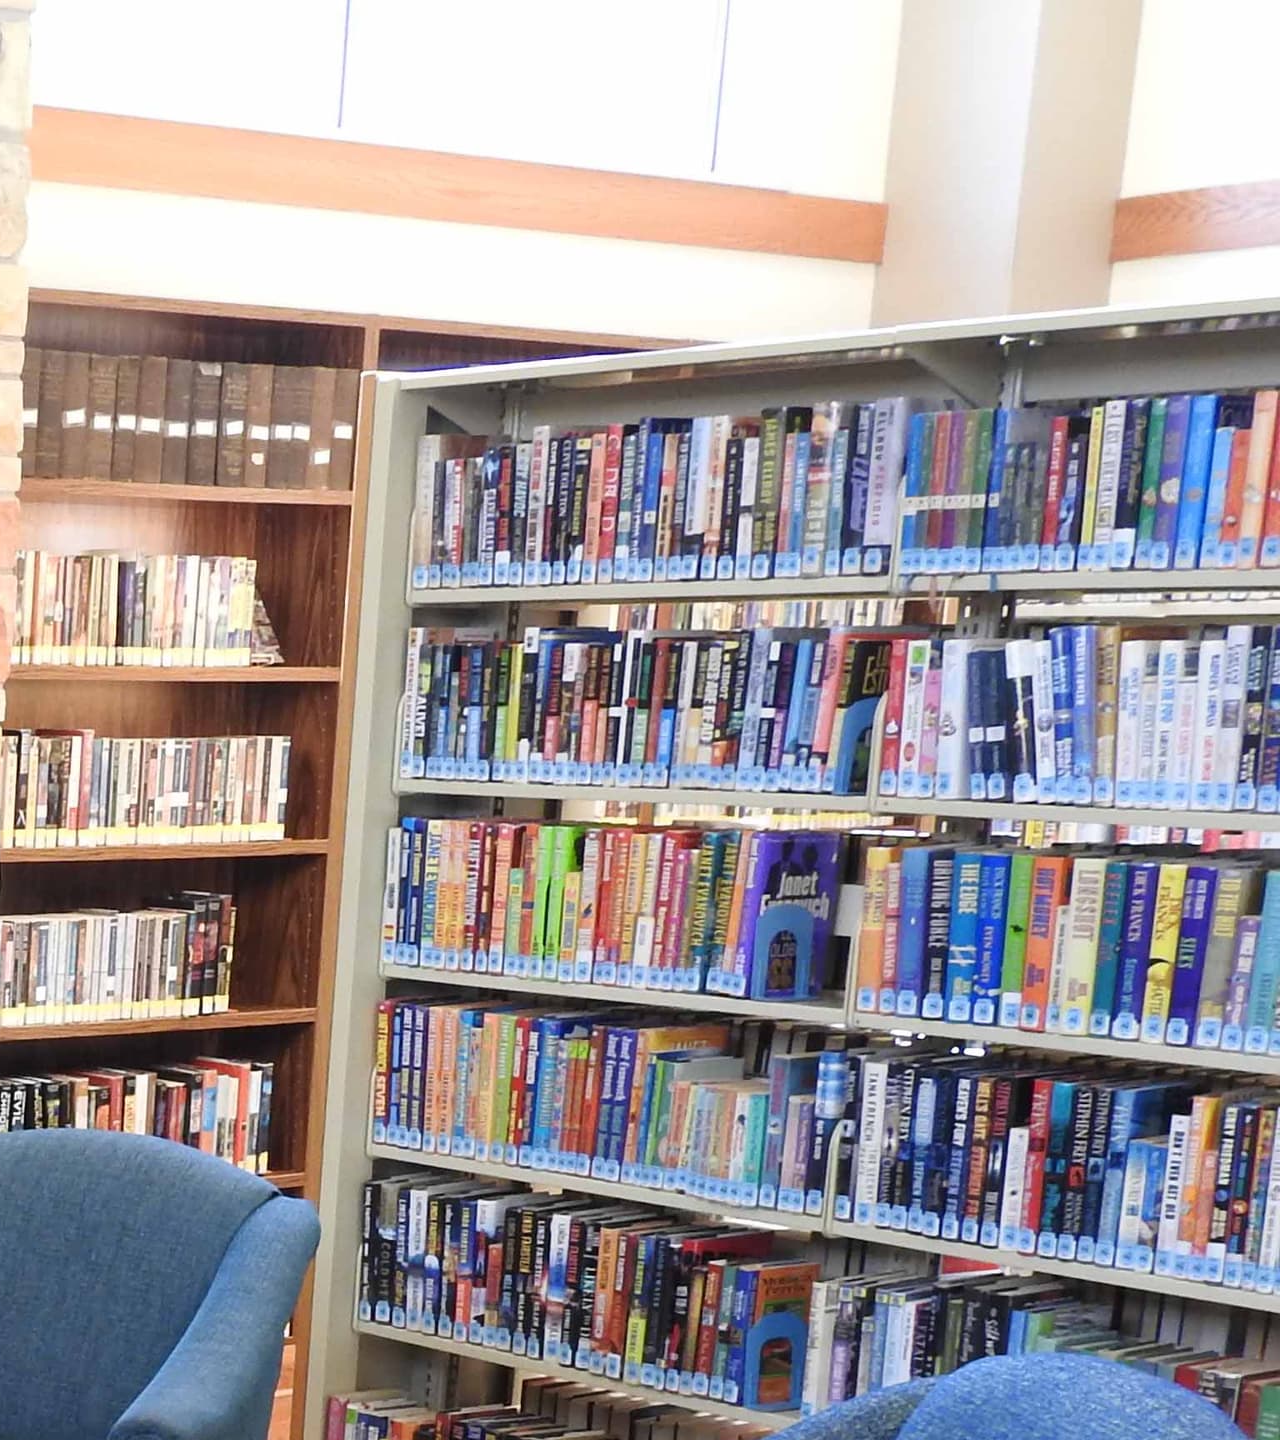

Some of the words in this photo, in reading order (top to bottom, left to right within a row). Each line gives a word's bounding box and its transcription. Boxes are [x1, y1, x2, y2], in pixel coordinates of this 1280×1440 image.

[562, 440, 572, 468] CLIVE
[763, 418, 779, 456] JAMES
[513, 481, 528, 517] HAVOC
[559, 472, 571, 516] EGLETON
[761, 461, 775, 504] ELLROY
[720, 664, 731, 699] SHOOT
[733, 670, 745, 710] ESTLEMAN
[700, 706, 716, 741] DEAD
[428, 833, 442, 867] JANET
[467, 840, 480, 868] JANET
[701, 845, 715, 878] JANET
[723, 843, 738, 875] JANET
[776, 870, 819, 899] Janet
[931, 860, 953, 908] DRIVING
[961, 864, 980, 884] THE
[1036, 868, 1056, 894] HOT
[1132, 871, 1148, 896] DICK
[423, 872, 438, 938] EVANOVICH
[464, 872, 478, 926] EVANOVICH
[691, 882, 710, 946] EVANOVICH
[713, 880, 733, 945] EVANOVICH
[958, 886, 979, 914] EDGE
[1072, 870, 1100, 941] LONGSHOT
[1103, 873, 1121, 924] REFLEX
[1153, 886, 1171, 941] FRANCIS
[1168, 897, 1181, 928] DICK
[1217, 895, 1239, 912] THE
[928, 913, 950, 948] FORCE
[1030, 895, 1054, 938] MONEY
[1126, 900, 1144, 942] FRANCIS
[983, 926, 994, 948] EVEN
[1178, 937, 1197, 969] SILKS
[1121, 958, 1138, 992] SECOND
[375, 1075, 386, 1116] SEVEN
[868, 1073, 879, 1097] TANA
[902, 1069, 914, 1114] STEPHEN
[954, 1079, 971, 1121] HEAVEN'S
[975, 1081, 991, 1112] HELL'S
[12, 1090, 23, 1125] EVIL
[865, 1101, 877, 1141] FRENCH
[1075, 1093, 1092, 1139] STEPHEN
[1093, 1093, 1110, 1132] STEPHEN
[899, 1116, 912, 1141] FREY
[952, 1123, 966, 1146] FURY
[973, 1116, 988, 1140] GATE
[1092, 1133, 1105, 1155] FREY
[1071, 1140, 1088, 1165] FREY
[1217, 1138, 1234, 1185] FRIEDMAN
[967, 1145, 986, 1196] STEPHEN
[1166, 1184, 1178, 1200] GET
[521, 1212, 533, 1233] LINDA
[1165, 1203, 1176, 1220] OLD
[536, 1220, 546, 1245] LINDA
[381, 1242, 391, 1276] COLD
[520, 1236, 532, 1273] FAIRSTEIN
[534, 1247, 544, 1286] FAIRSTEIN
[581, 1267, 596, 1311] LIKELY
